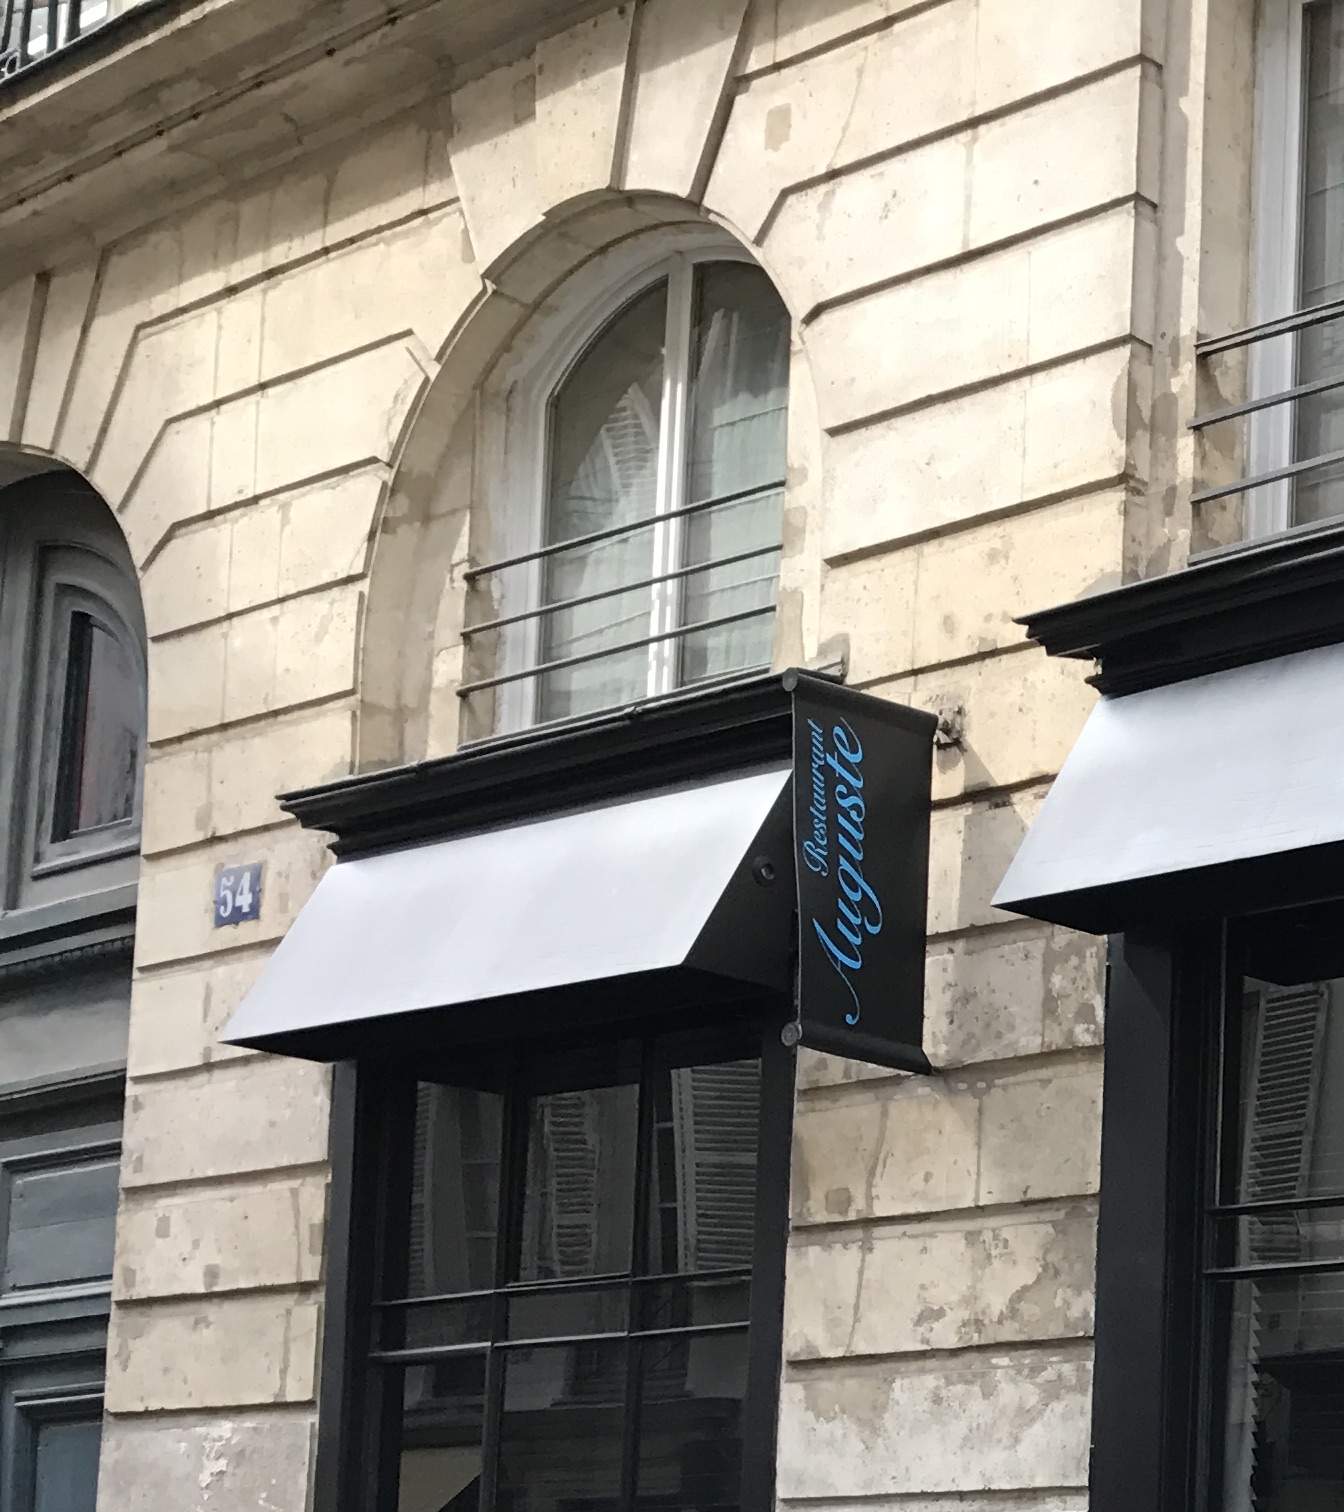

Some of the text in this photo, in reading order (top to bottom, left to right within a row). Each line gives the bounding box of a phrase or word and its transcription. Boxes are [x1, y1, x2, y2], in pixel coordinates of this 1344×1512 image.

[801, 717, 829, 878] Restaurant
[812, 716, 883, 1025] Auguste
[219, 871, 253, 918] 54
